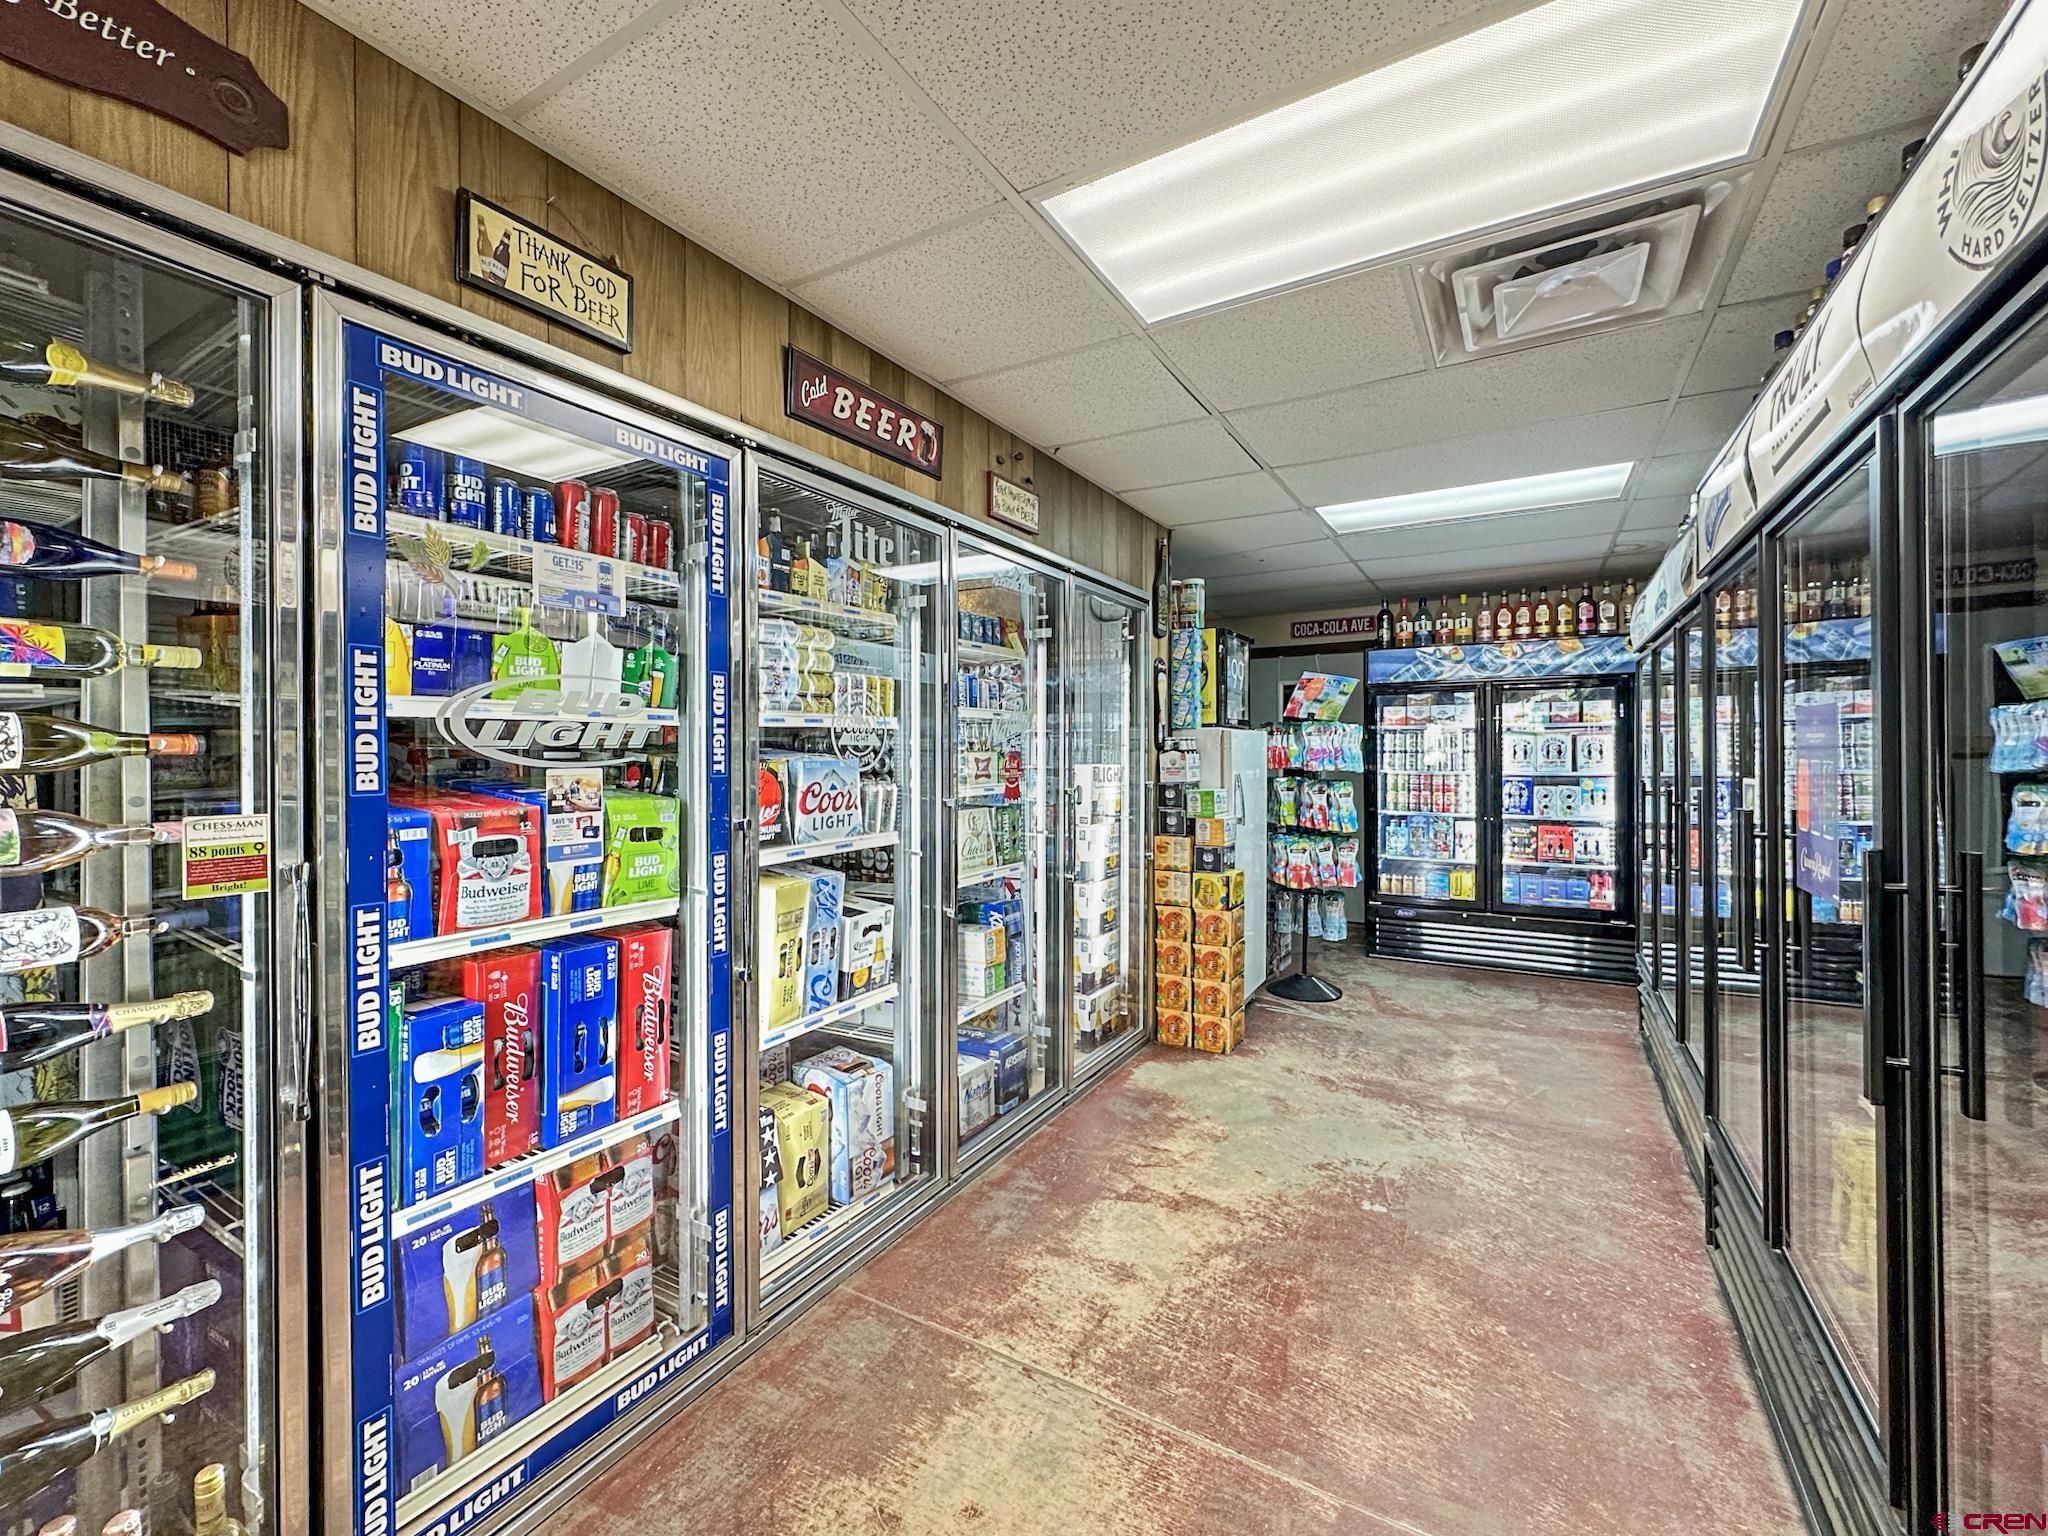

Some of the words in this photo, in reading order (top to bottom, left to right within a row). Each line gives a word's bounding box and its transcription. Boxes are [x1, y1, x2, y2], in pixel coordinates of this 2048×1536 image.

[1961, 233, 2004, 258] HARD
[2009, 75, 2042, 229] SELTZER
[512, 227, 575, 288] THANK
[580, 264, 617, 300] GOD
[520, 262, 567, 308] FOR
[573, 285, 625, 338] BEER
[381, 343, 445, 381] BUD
[446, 367, 524, 409] LIGHT
[1769, 307, 1833, 432] TRULY
[801, 375, 829, 407] Cold
[832, 386, 917, 450] BEER
[353, 387, 378, 472] LIGHT
[616, 427, 656, 454] BUD
[656, 443, 710, 473] LIGHT
[354, 473, 378, 534] BUD
[710, 493, 725, 534] BUD
[830, 517, 895, 567] Lite
[552, 556, 570, 568] GET
[710, 535, 725, 595] LIGHT
[1294, 620, 1348, 637] COCA-COLA
[1350, 618, 1374, 632] AVE.
[413, 661, 451, 670] PLATINUM
[509, 664, 547, 677] LIGHT
[514, 656, 543, 666] BUD
[354, 649, 379, 718] LIGHT
[518, 680, 538, 689] LIME
[711, 674, 726, 713] BUD
[513, 689, 645, 716] BUD
[474, 720, 660, 749] LIGHT
[711, 713, 726, 775] LIGHT
[354, 720, 380, 792] BUD
[520, 822, 532, 831] 12
[812, 813, 853, 831] LIGHT
[189, 846, 207, 858] 88
[211, 845, 246, 858] points
[634, 855, 660, 867] BUD
[211, 881, 247, 892] Bright!
[572, 881, 598, 893] LIGHT
[574, 872, 597, 883] BUD
[629, 864, 665, 878] LIGHT
[637, 879, 655, 889] LIME
[712, 853, 727, 892] BUD
[461, 882, 529, 899] Budweiser
[387, 918, 407, 927] UD
[711, 893, 727, 956] LIGHT
[356, 908, 381, 977] LIGHT
[586, 967, 595, 998] LIGHT
[594, 968, 603, 992] BUD
[115, 1002, 169, 1016] CHANDON
[356, 978, 381, 1052] BUD
[642, 965, 667, 1082] Budweiser
[463, 1017, 473, 1044] BUD
[472, 1014, 483, 1044] LIGHT
[503, 992, 529, 1123] Budweiser
[713, 1032, 727, 1073] BUD
[225, 1068, 237, 1116] ROCK
[713, 1074, 727, 1133] LIGHT
[875, 1073, 884, 1107] Coors
[560, 1111, 570, 1138] LIGHT
[569, 1110, 578, 1134] BUD
[875, 1108, 884, 1138] LIGHT
[436, 1157, 446, 1185] BUD
[446, 1149, 456, 1184] LIGHT
[359, 1161, 384, 1239] LIGHT
[611, 1188, 652, 1214] Budweiser
[411, 1236, 428, 1250] 20
[560, 1213, 605, 1241] Budweiser
[714, 1212, 727, 1253] BUD
[361, 1240, 385, 1308] BUD
[714, 1254, 728, 1309] LIGHT
[478, 1287, 507, 1310] LIGHT
[481, 1282, 504, 1300] BUD
[555, 1326, 603, 1360] Budweiser
[403, 1376, 420, 1391] 20
[617, 1374, 659, 1412] BUD
[659, 1333, 710, 1380] LIGHT
[477, 1415, 507, 1441] LIGHT
[480, 1410, 504, 1430] BUD
[363, 1414, 388, 1503] LIGHT
[450, 1464, 525, 1531] LIGHT
[364, 1497, 388, 1536] UD
